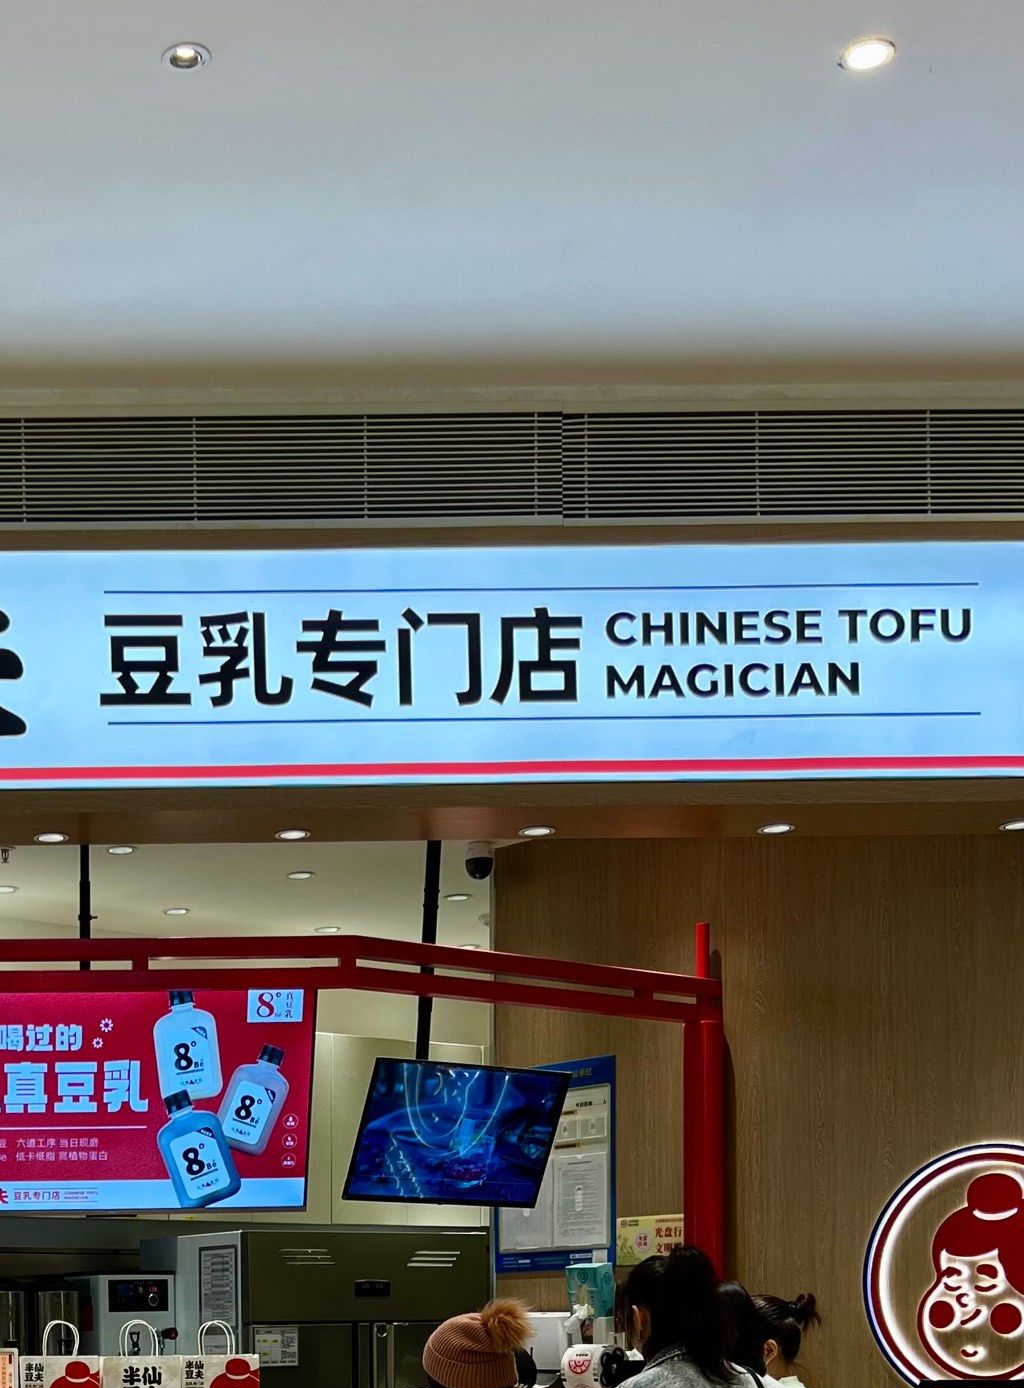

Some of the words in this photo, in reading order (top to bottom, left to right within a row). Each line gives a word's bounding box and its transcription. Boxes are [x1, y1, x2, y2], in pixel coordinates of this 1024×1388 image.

[605, 609, 823, 646] CHINESE
[838, 608, 972, 643] TOFU
[100, 608, 582, 709] 豆乳专门店
[606, 662, 862, 699] MAGICIAN
[13, 1191, 60, 1200] 豆乳专门店
[122, 1366, 162, 1386] 半仙
